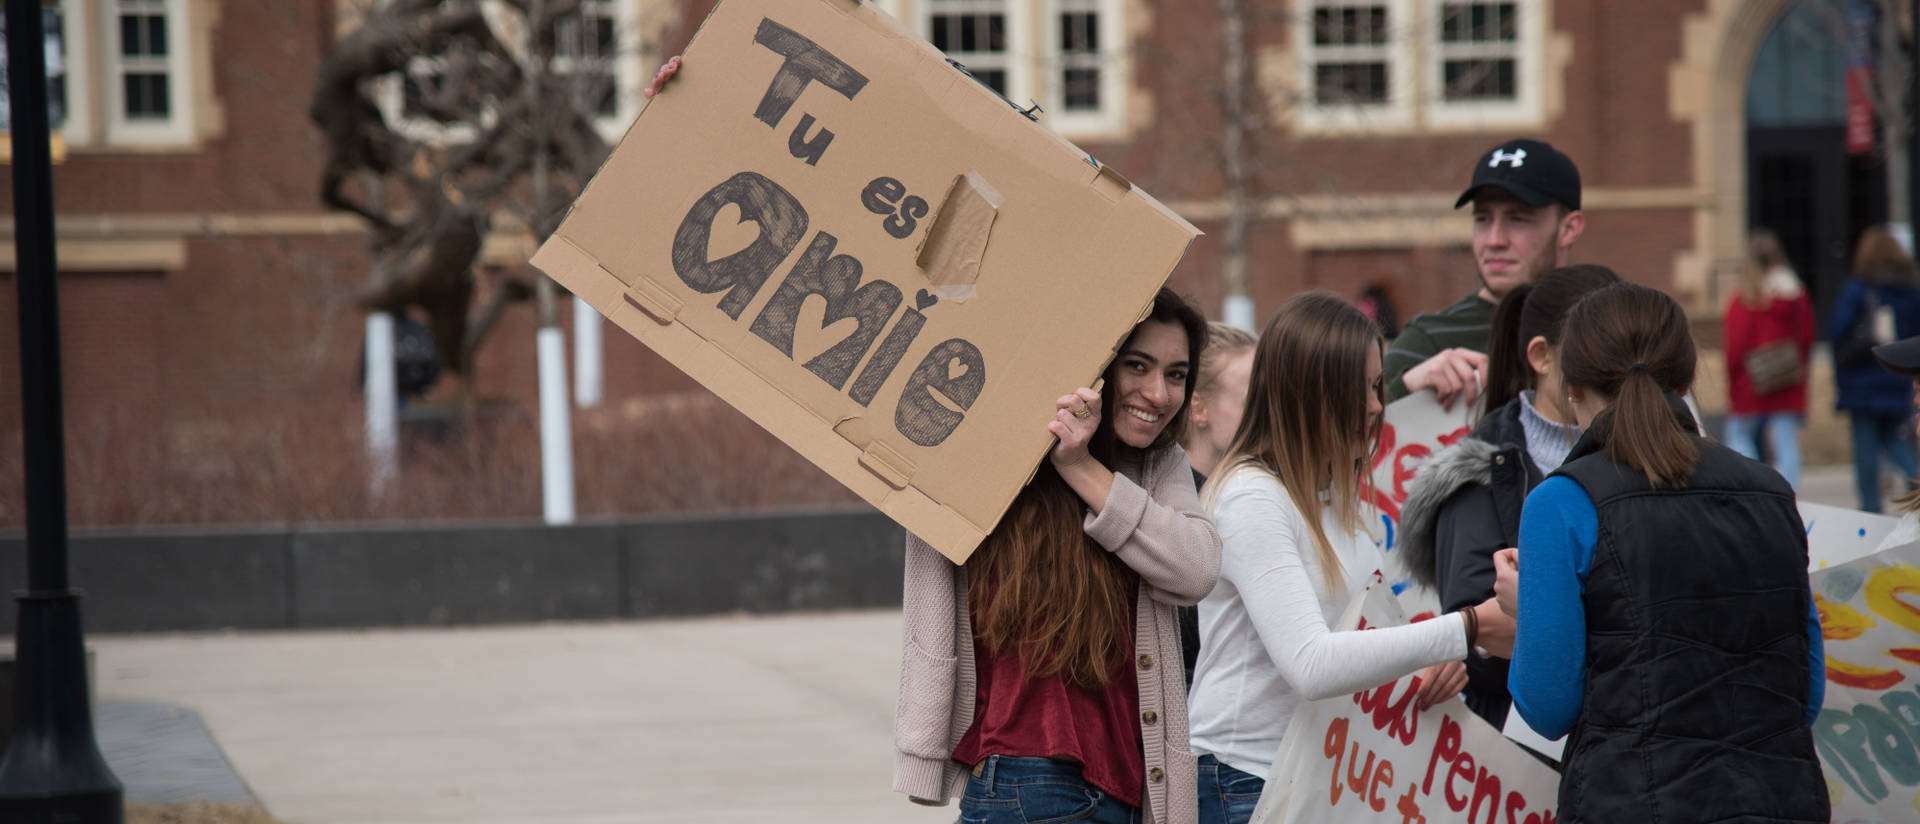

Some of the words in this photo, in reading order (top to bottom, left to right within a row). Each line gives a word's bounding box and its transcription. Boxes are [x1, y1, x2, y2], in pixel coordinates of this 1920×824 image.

[753, 17, 870, 166] Tu
[860, 176, 929, 239] es
[671, 171, 986, 447] amie
[1324, 716, 1394, 812] que
